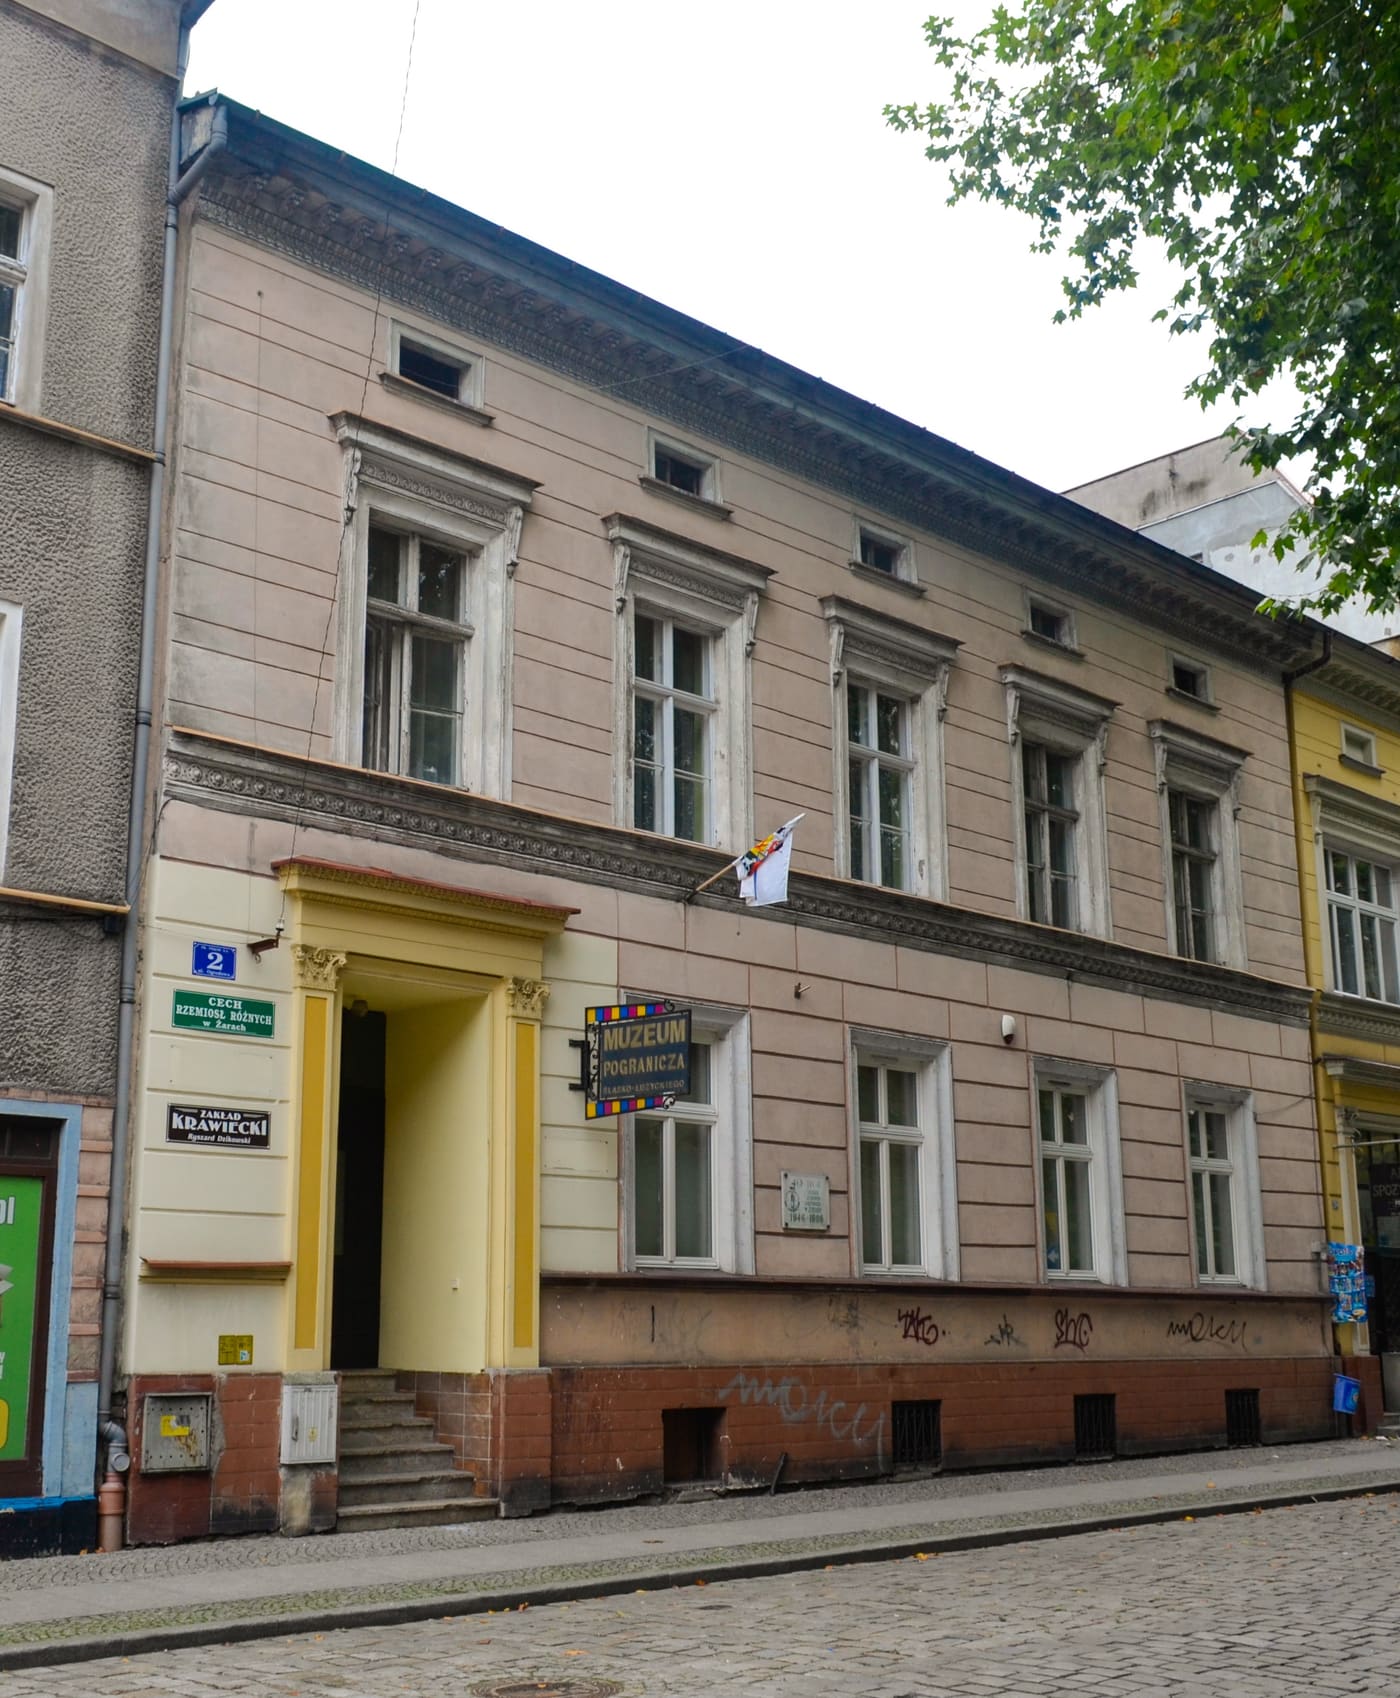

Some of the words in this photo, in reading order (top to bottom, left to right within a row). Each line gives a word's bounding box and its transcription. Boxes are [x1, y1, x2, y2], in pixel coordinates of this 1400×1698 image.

[206, 952, 223, 971] 2
[208, 997, 242, 1009] CECH
[175, 1004, 226, 1020] RZEMIOSŁ
[230, 1010, 272, 1025] RÓŻNYCH
[215, 1019, 247, 1032] Żarach
[604, 1019, 686, 1051] MUZEUM
[604, 1053, 685, 1077] POGRANICZA
[171, 1112, 267, 1136] KRAWIECKI
[200, 1109, 242, 1121] ZAKŁAD
[187, 1132, 216, 1143] Ryszard
